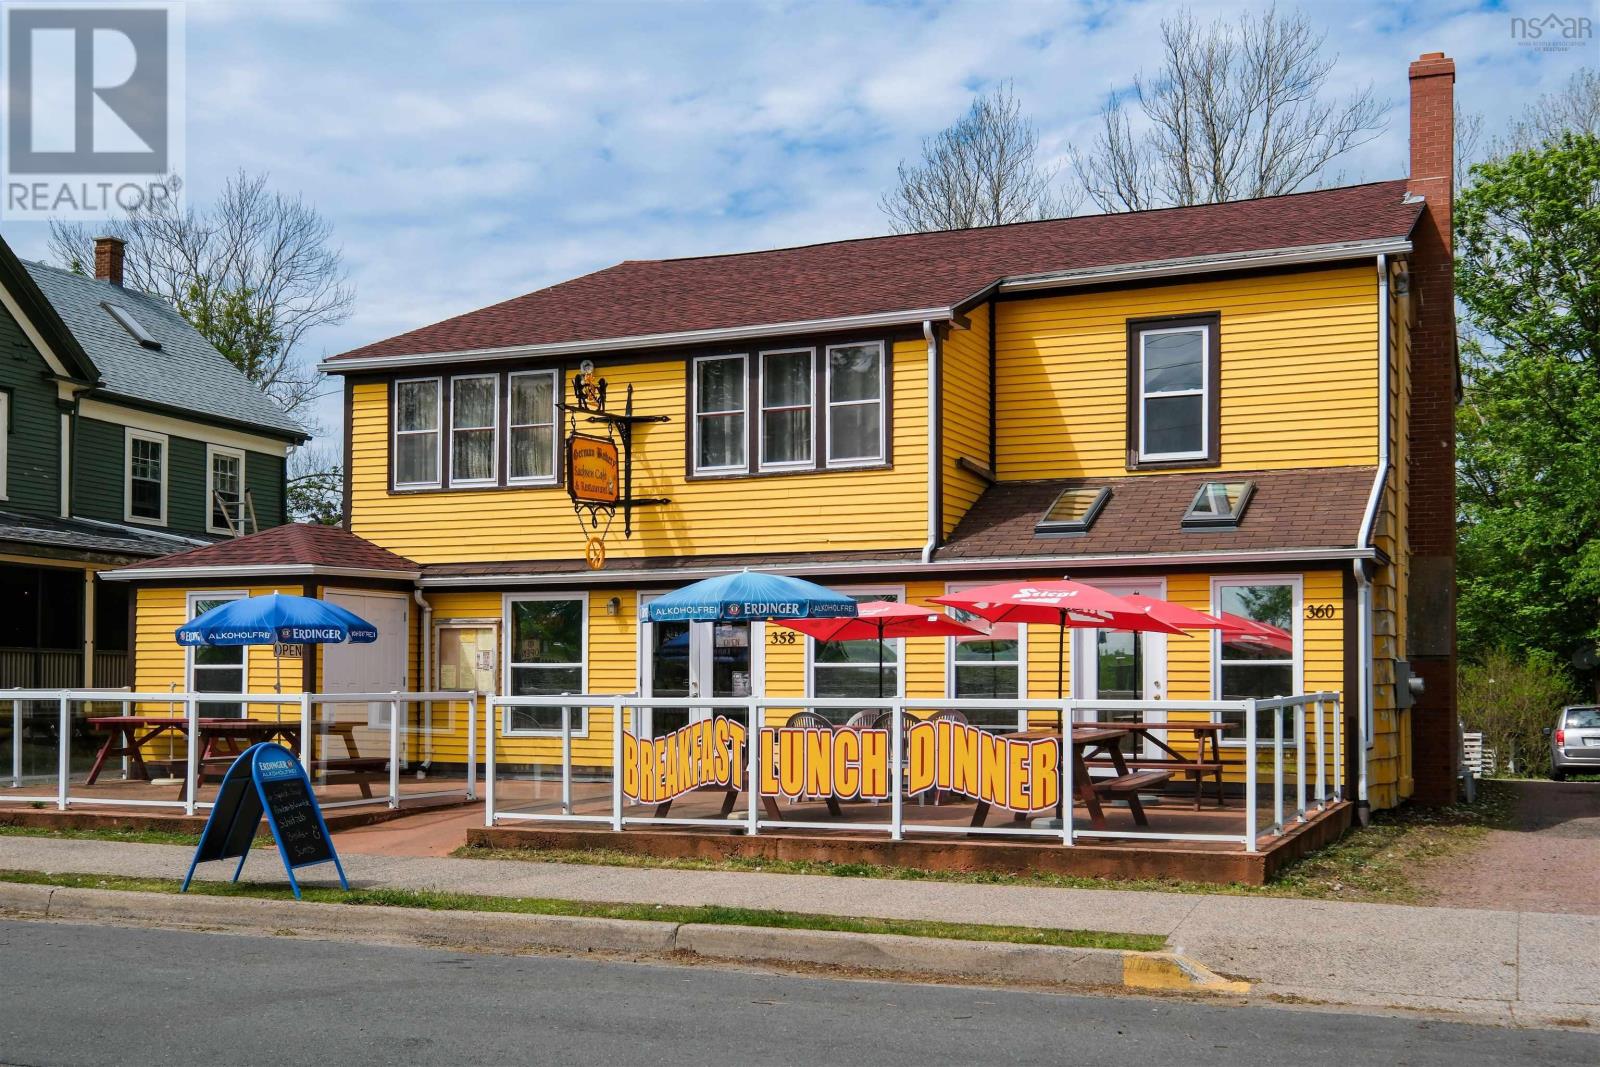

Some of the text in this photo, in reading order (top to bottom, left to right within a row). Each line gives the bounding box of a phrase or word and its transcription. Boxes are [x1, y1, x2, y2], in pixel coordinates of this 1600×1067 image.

[656, 606, 717, 615] ALKOHOLFREI
[744, 603, 800, 615] ERDINGER
[814, 604, 855, 612] ALKOHOLFREI
[1306, 603, 1334, 619] 360
[292, 628, 341, 640] ERDINGER
[770, 631, 796, 645] 358
[274, 643, 302, 656] OPEN
[623, 715, 1060, 813] BREAKFAST LUNCH DINNER
